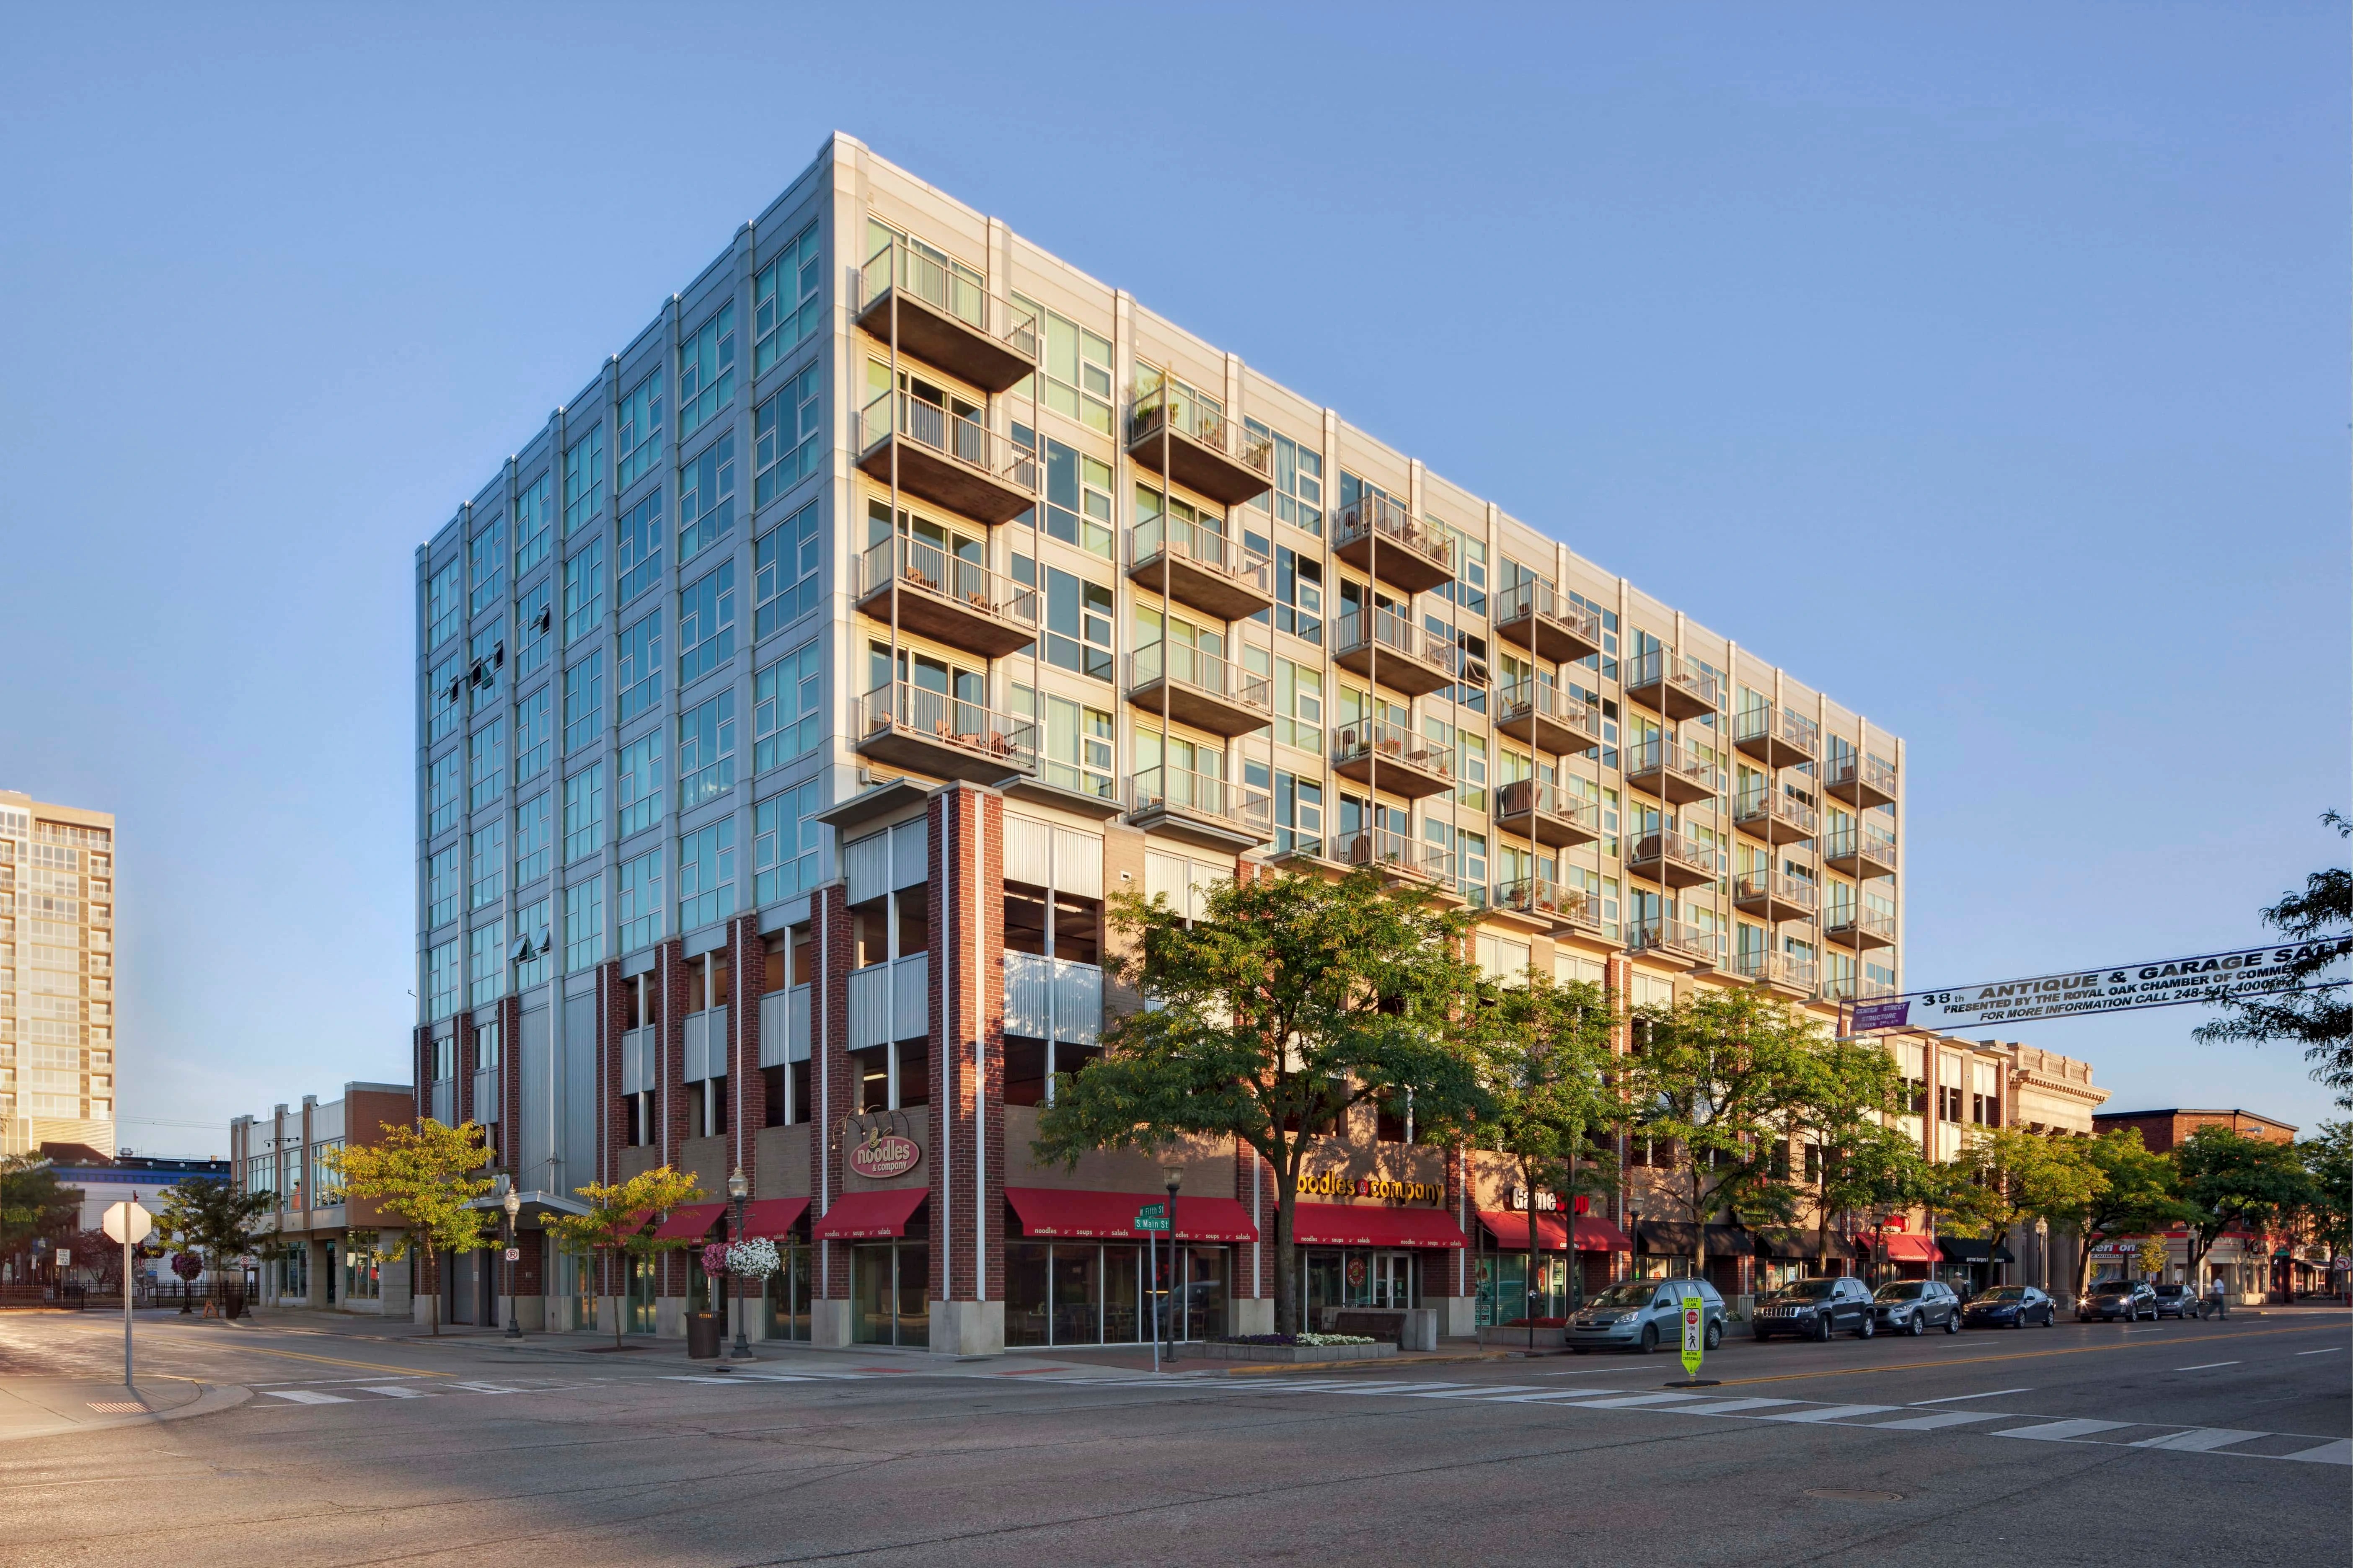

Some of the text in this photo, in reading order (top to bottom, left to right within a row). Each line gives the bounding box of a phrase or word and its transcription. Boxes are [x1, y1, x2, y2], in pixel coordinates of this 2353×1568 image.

[1922, 993, 1950, 1006] 38
[1978, 974, 2099, 1000] ANTIQUE
[2107, 971, 2127, 983] &
[2138, 953, 2263, 980] GARAGE
[1944, 999, 2012, 1013] PRESENTED
[2014, 996, 2032, 1006] BY
[2035, 993, 2061, 1004] THE
[2063, 989, 2105, 1001] ROYAL
[2108, 984, 2138, 995] OAK
[2140, 975, 2209, 991] CHAMBER
[2213, 973, 2232, 983] OF
[1861, 1013, 1897, 1022] STRUCTURE
[1980, 1011, 2005, 1021] FOR
[2007, 1006, 2043, 1018] MORE
[2045, 996, 2132, 1014] INFORMATION
[2135, 992, 2169, 1004] CALL
[858, 1139, 910, 1164] noodles
[878, 1161, 907, 1173] company
[1296, 1170, 1355, 1196] oodles
[1370, 1181, 1444, 1206] company
[1145, 1206, 1157, 1216] Fifth
[1158, 1205, 1164, 1214] St
[1143, 1219, 1158, 1228] Main
